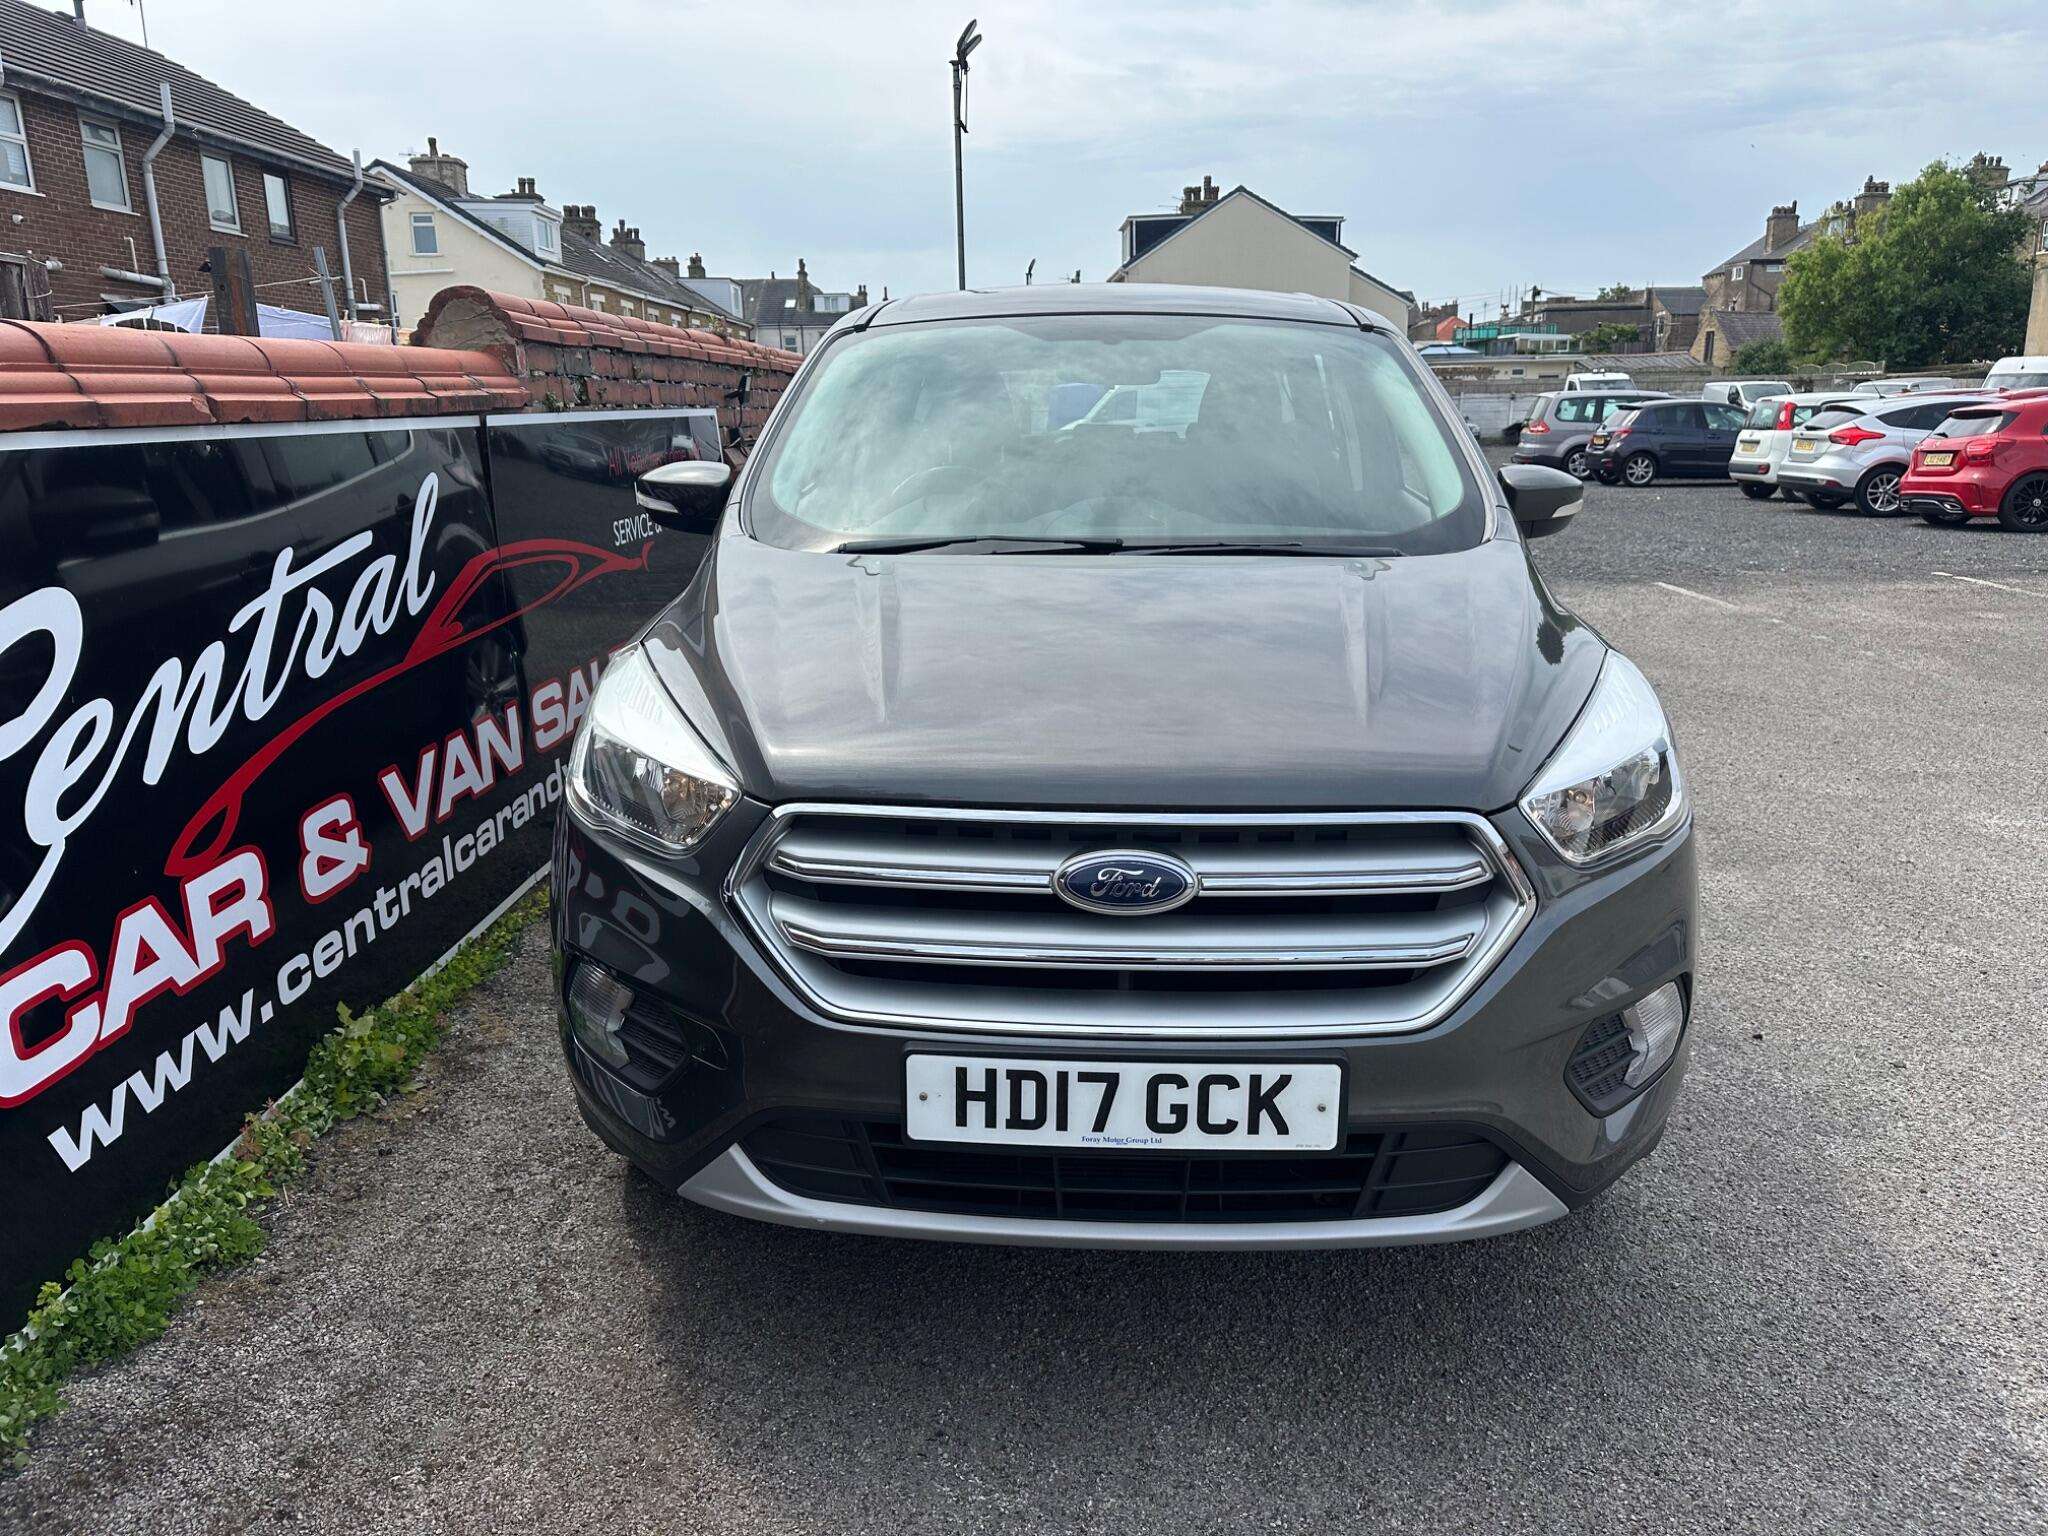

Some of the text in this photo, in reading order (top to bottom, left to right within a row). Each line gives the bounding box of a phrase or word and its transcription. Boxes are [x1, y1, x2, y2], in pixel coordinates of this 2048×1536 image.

[612, 512, 654, 547] SERVICE
[1090, 867, 1162, 898] Ford
[0, 846, 275, 1108] CAR
[300, 792, 372, 899] &
[378, 698, 524, 842] VAN
[955, 1066, 1294, 1136] HD17 GCK
[1103, 1136, 1124, 1144] Motor
[1125, 1136, 1149, 1145] Group
